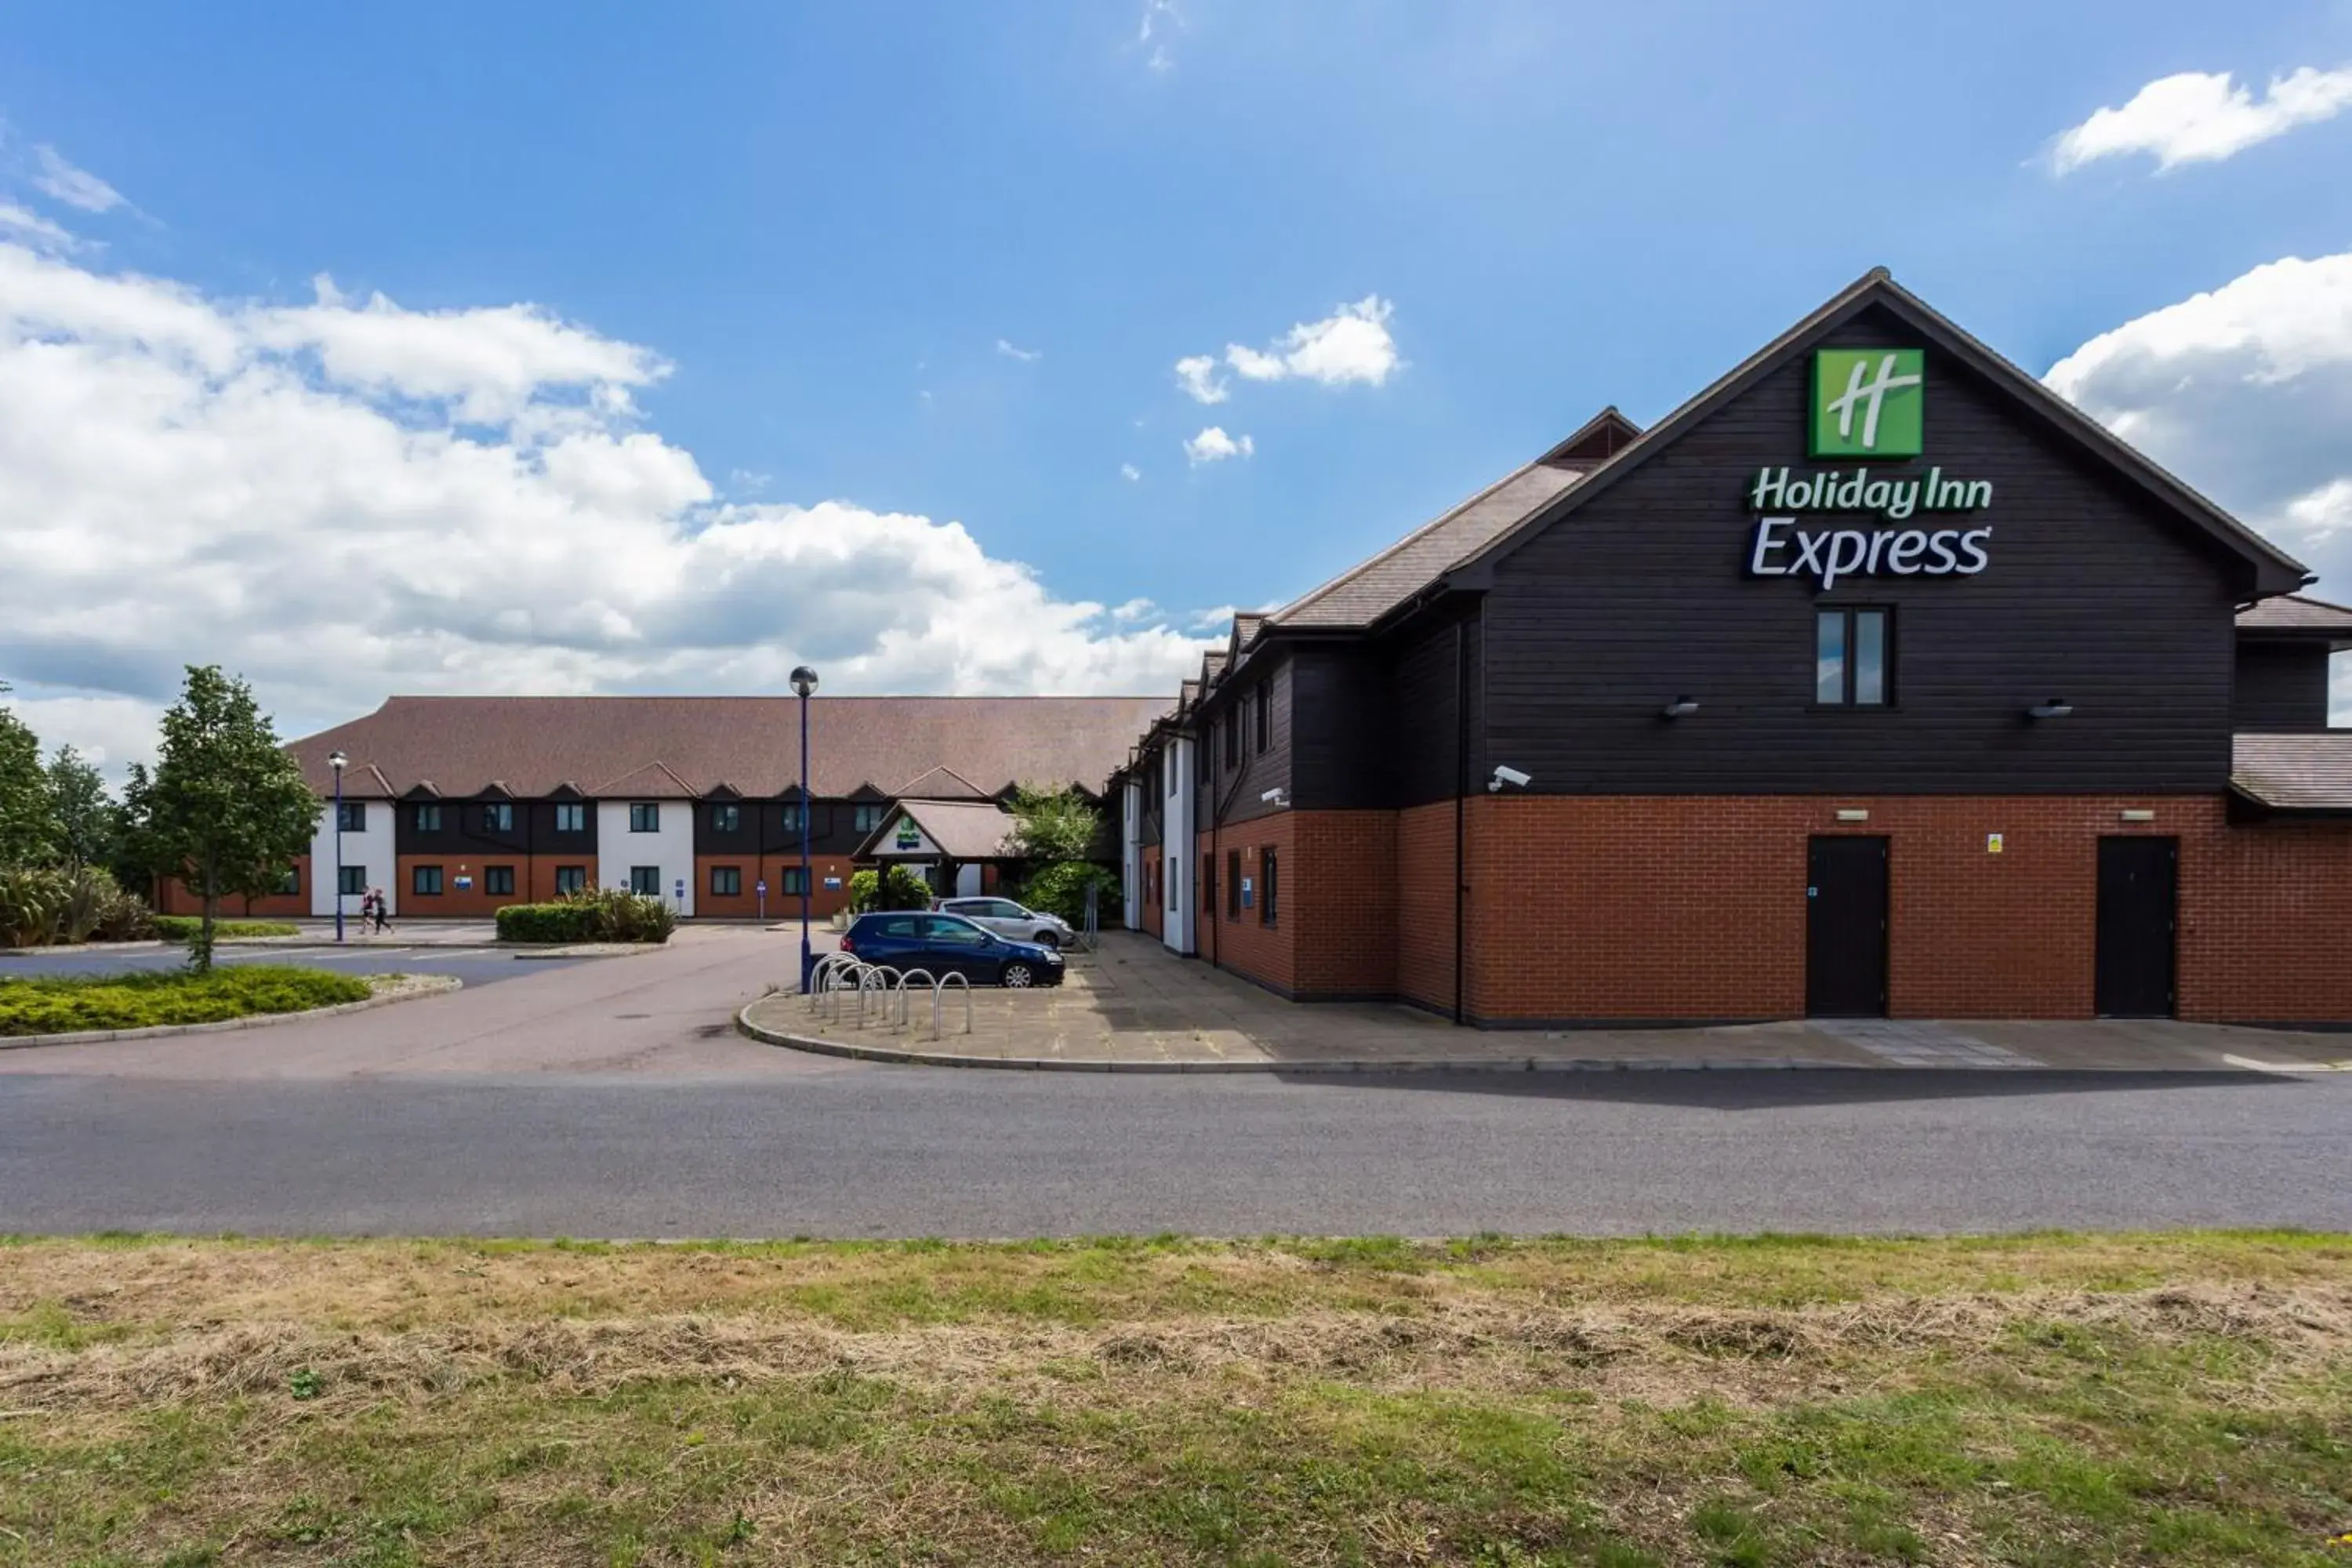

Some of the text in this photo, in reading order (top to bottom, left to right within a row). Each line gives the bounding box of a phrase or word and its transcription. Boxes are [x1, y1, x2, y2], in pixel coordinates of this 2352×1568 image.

[1827, 354, 1921, 448] H
[1751, 466, 1992, 519] Holiday Inn
[1751, 517, 1991, 590] Express
